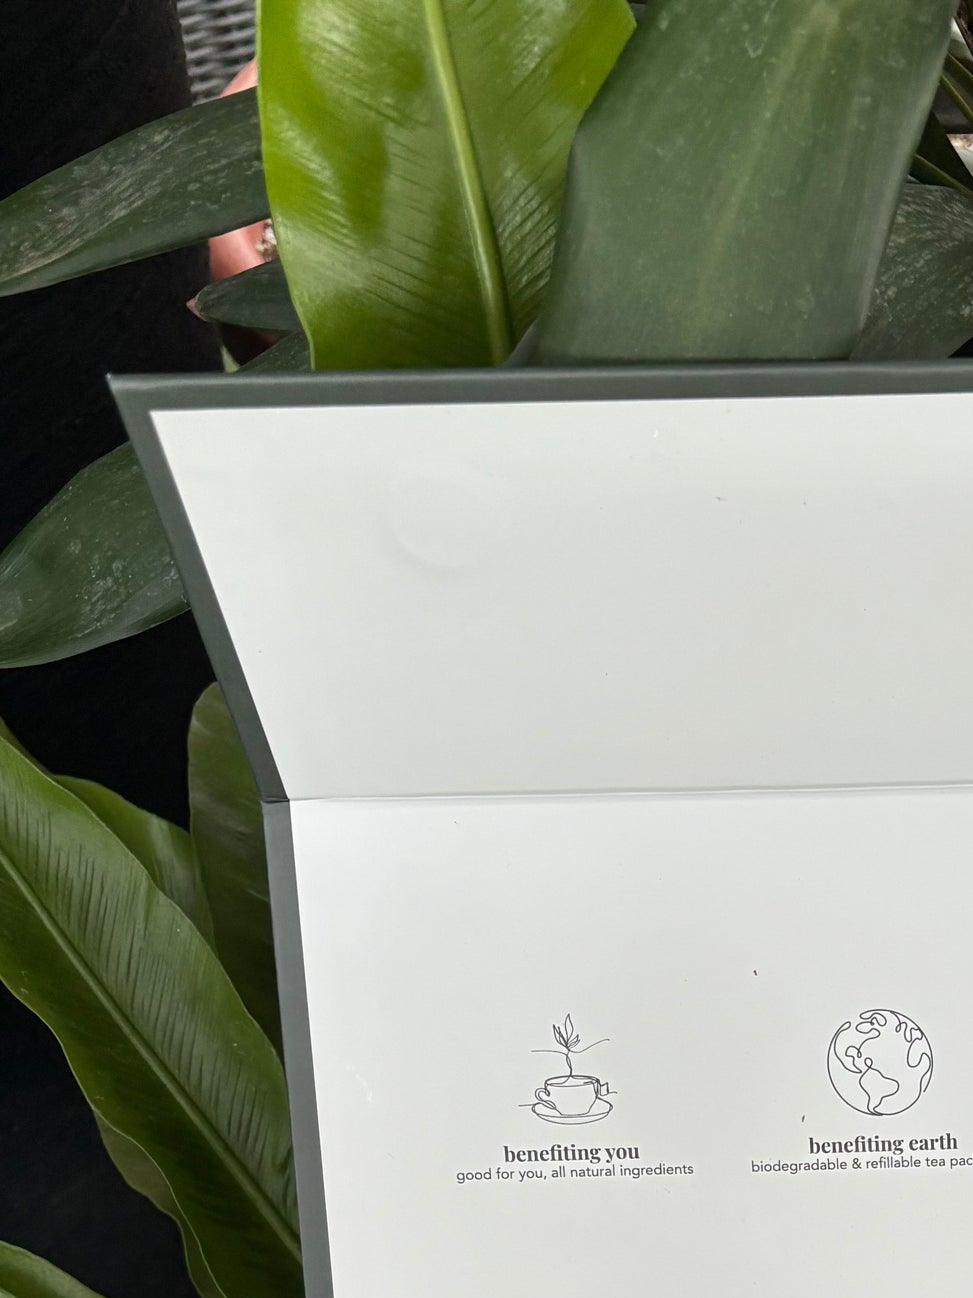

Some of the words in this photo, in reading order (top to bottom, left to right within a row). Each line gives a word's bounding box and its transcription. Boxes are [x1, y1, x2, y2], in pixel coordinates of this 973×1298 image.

[504, 1144, 600, 1164] benefiting
[605, 1146, 640, 1163] you
[809, 1135, 904, 1155] benefiting
[908, 1133, 958, 1151] earth
[456, 1168, 492, 1184] good
[496, 1168, 515, 1180] for
[519, 1170, 547, 1182] you,
[552, 1166, 566, 1178] all
[570, 1165, 616, 1178] natural
[620, 1164, 694, 1179] ingredients
[752, 1157, 847, 1174] biodegradable
[852, 1157, 862, 1170] &
[866, 1156, 921, 1169] refillable
[926, 1156, 946, 1168] tea
